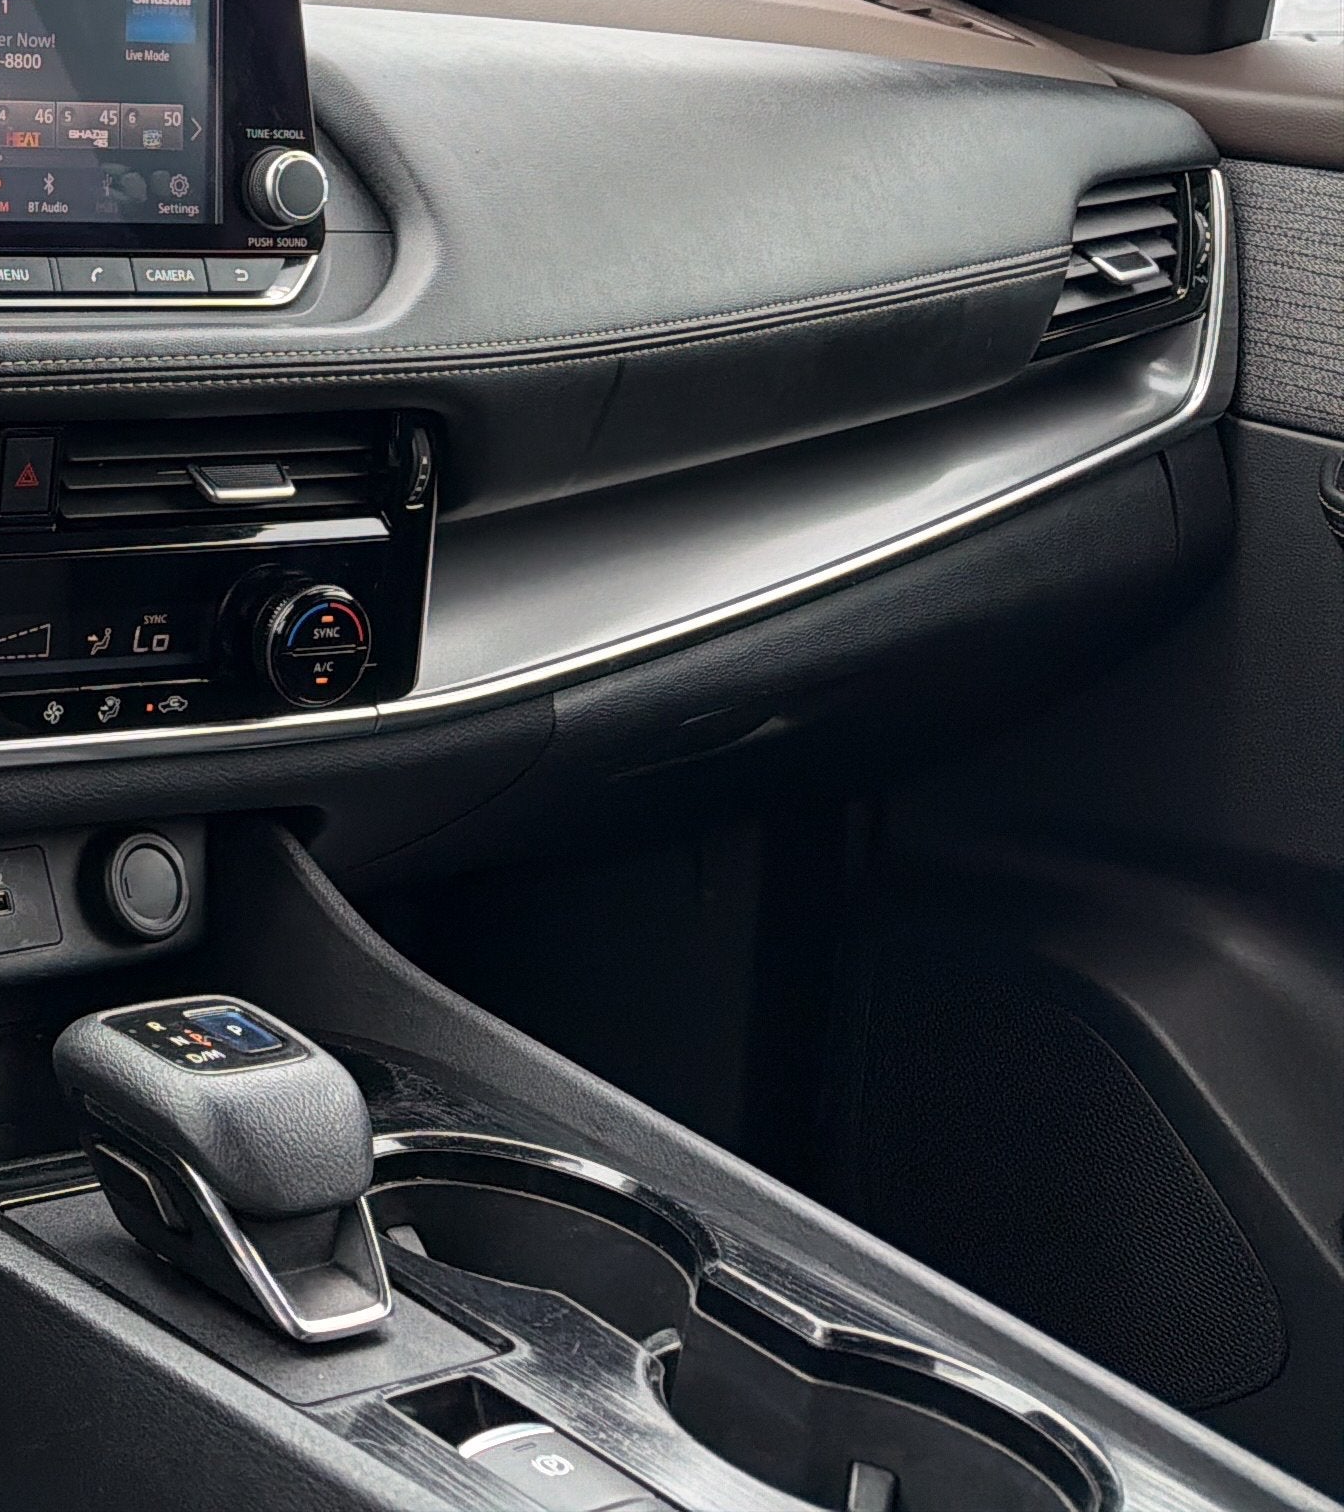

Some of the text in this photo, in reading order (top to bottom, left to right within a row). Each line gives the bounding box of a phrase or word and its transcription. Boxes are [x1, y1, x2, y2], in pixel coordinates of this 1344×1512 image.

[17, 32, 56, 49] Now!
[125, 49, 170, 63] Live Mode
[34, 109, 54, 125] 46
[64, 109, 118, 126] 5 45
[128, 111, 182, 127] 6 50
[27, 201, 69, 214] BT Audio
[157, 202, 200, 217] Settings
[248, 237, 308, 248] PUSH SOUND
[145, 269, 196, 282] CAMERA
[143, 613, 168, 626] SYNC
[313, 626, 341, 639] SYNC
[313, 661, 335, 673] A/C
[226, 1024, 243, 1037] P
